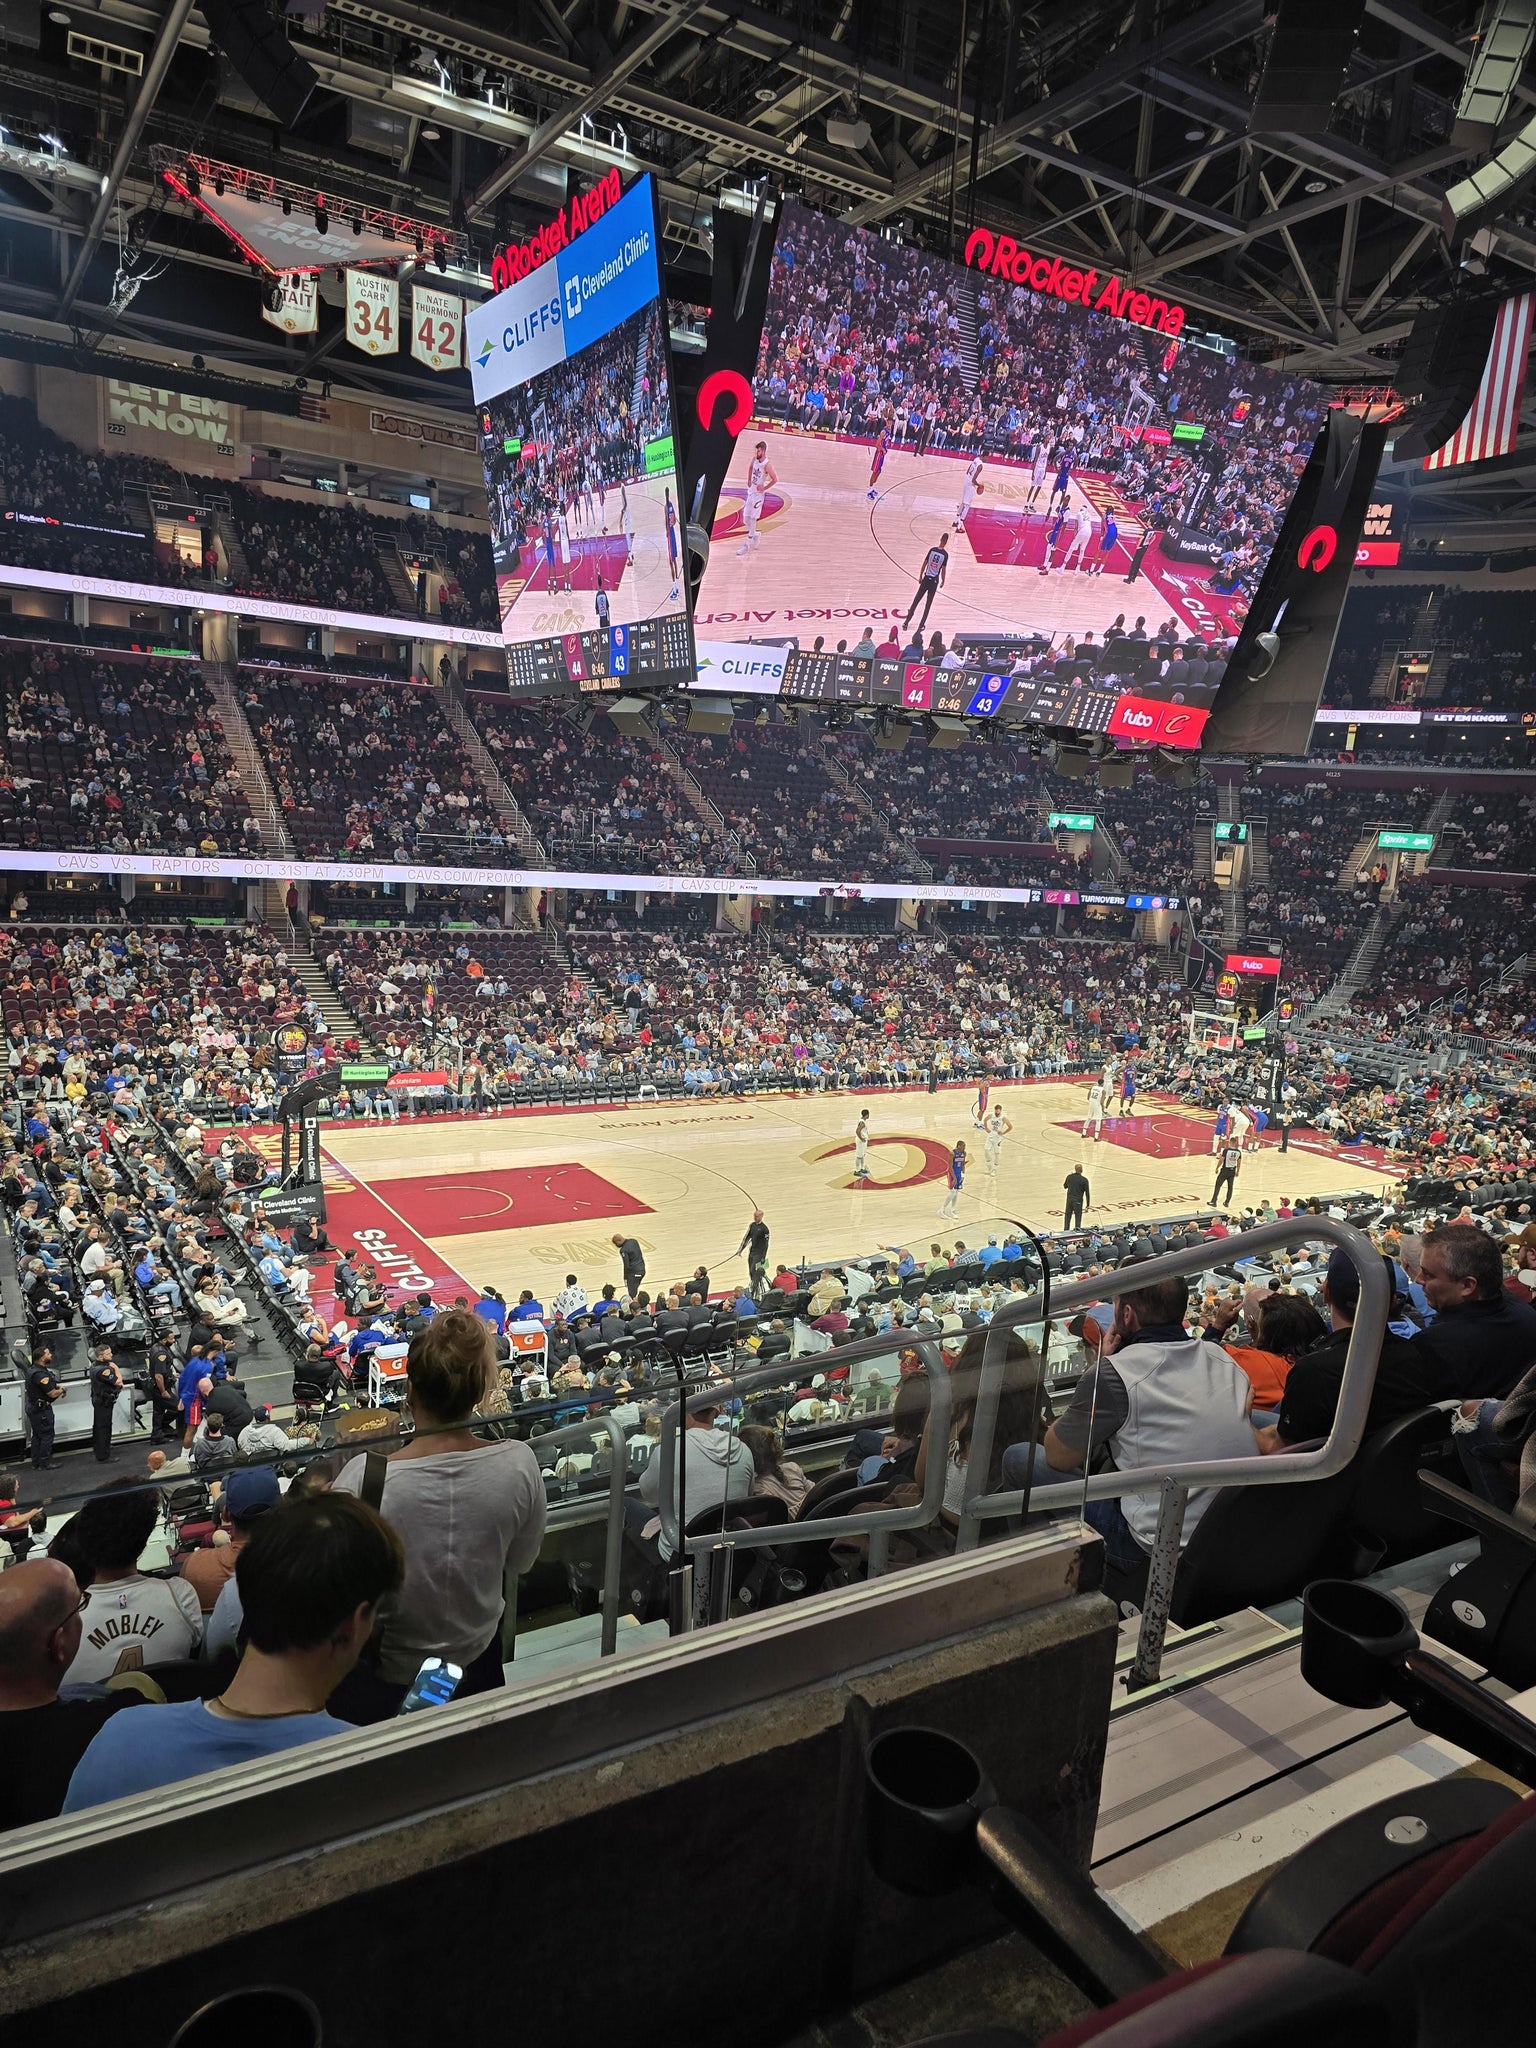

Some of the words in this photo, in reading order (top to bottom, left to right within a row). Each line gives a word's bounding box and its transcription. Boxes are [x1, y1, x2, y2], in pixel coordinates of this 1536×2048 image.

[506, 208, 569, 284] Rocket
[570, 167, 622, 240] Arena
[248, 225, 352, 259] KNOW.
[581, 249, 623, 300] Cleveland
[624, 231, 650, 268] Clinic
[356, 277, 390, 293] AUSTIN
[991, 235, 1097, 307] Rocket
[1095, 276, 1185, 336] Arena
[281, 289, 312, 307] TAIT
[360, 289, 386, 302] CARR
[426, 295, 449, 308] NATE
[416, 302, 459, 321] THURMOND
[354, 300, 392, 341] 34
[502, 297, 562, 353] CLIFFS
[418, 317, 455, 357] 42
[180, 393, 229, 421] EM
[109, 397, 234, 445] KNOW.
[108, 425, 126, 434] 222
[218, 446, 235, 456] 223
[157, 503, 168, 511] 222
[195, 509, 207, 517] 223
[1179, 539, 1209, 552] KeyBank
[402, 553, 414, 561] 223
[418, 555, 429, 563] 224
[72, 579, 100, 592] OCT.
[104, 582, 135, 597] 31ST
[138, 587, 154, 598] AT
[157, 589, 204, 606] 7:30PM
[226, 600, 337, 624] CAVS.COM/PROMO
[532, 613, 586, 633] CAVS
[694, 610, 776, 625] Aren
[783, 608, 889, 620] Rocket
[460, 630, 491, 645] CAVS
[572, 661, 582, 676] 44
[591, 662, 605, 676] 8:46
[615, 655, 626, 672] 43
[721, 659, 783, 678] CLIFFS
[880, 663, 899, 672] FOULS
[883, 675, 890, 684] 2
[936, 673, 948, 683] 2Q
[967, 677, 977, 686] 24
[1017, 681, 1036, 690] FOULS
[857, 690, 863, 698] 4
[1017, 693, 1025, 702] 2
[1060, 688, 1069, 697] 51
[907, 690, 923, 704] 44
[938, 697, 961, 711] 8:46
[976, 698, 993, 712] 43
[1054, 701, 1064, 709] 50
[1121, 708, 1153, 728] fubo
[1368, 706, 1414, 719] RAPTORS
[1433, 714, 1454, 722] LET
[1471, 714, 1508, 723] KNOW.
[1381, 834, 1410, 845] Sprite
[57, 855, 99, 869] CAVS
[111, 857, 137, 871] VS.
[151, 859, 220, 874] RAPTORS
[243, 863, 274, 876] OCT.
[278, 863, 311, 876] 31ST
[314, 867, 331, 877] AT
[335, 866, 384, 879] 7:30PM
[407, 869, 523, 884] CAVS.COM/PROMO
[681, 879, 711, 891] CAVS
[713, 881, 736, 892] CUP
[916, 887, 938, 897] CAVS
[942, 888, 957, 898] VS.
[963, 888, 1002, 898] RAPTORS
[1063, 894, 1071, 903] 8
[1080, 894, 1126, 905] TURNOVERS
[1135, 897, 1142, 906] 9
[1242, 961, 1264, 970] fubo
[1218, 982, 1234, 997] 24
[307, 1129, 316, 1161] Cleveland
[308, 1161, 316, 1180] Clinic
[263, 1198, 297, 1209] Cleveland
[297, 1196, 317, 1204] Clinic
[281, 1206, 302, 1214] Medicine
[353, 1227, 435, 1291] CLIFFS
[523, 1334, 534, 1345] G
[391, 1359, 403, 1370] G
[1463, 1607, 1474, 1621] 5
[86, 1613, 165, 1650] MOBLEY
